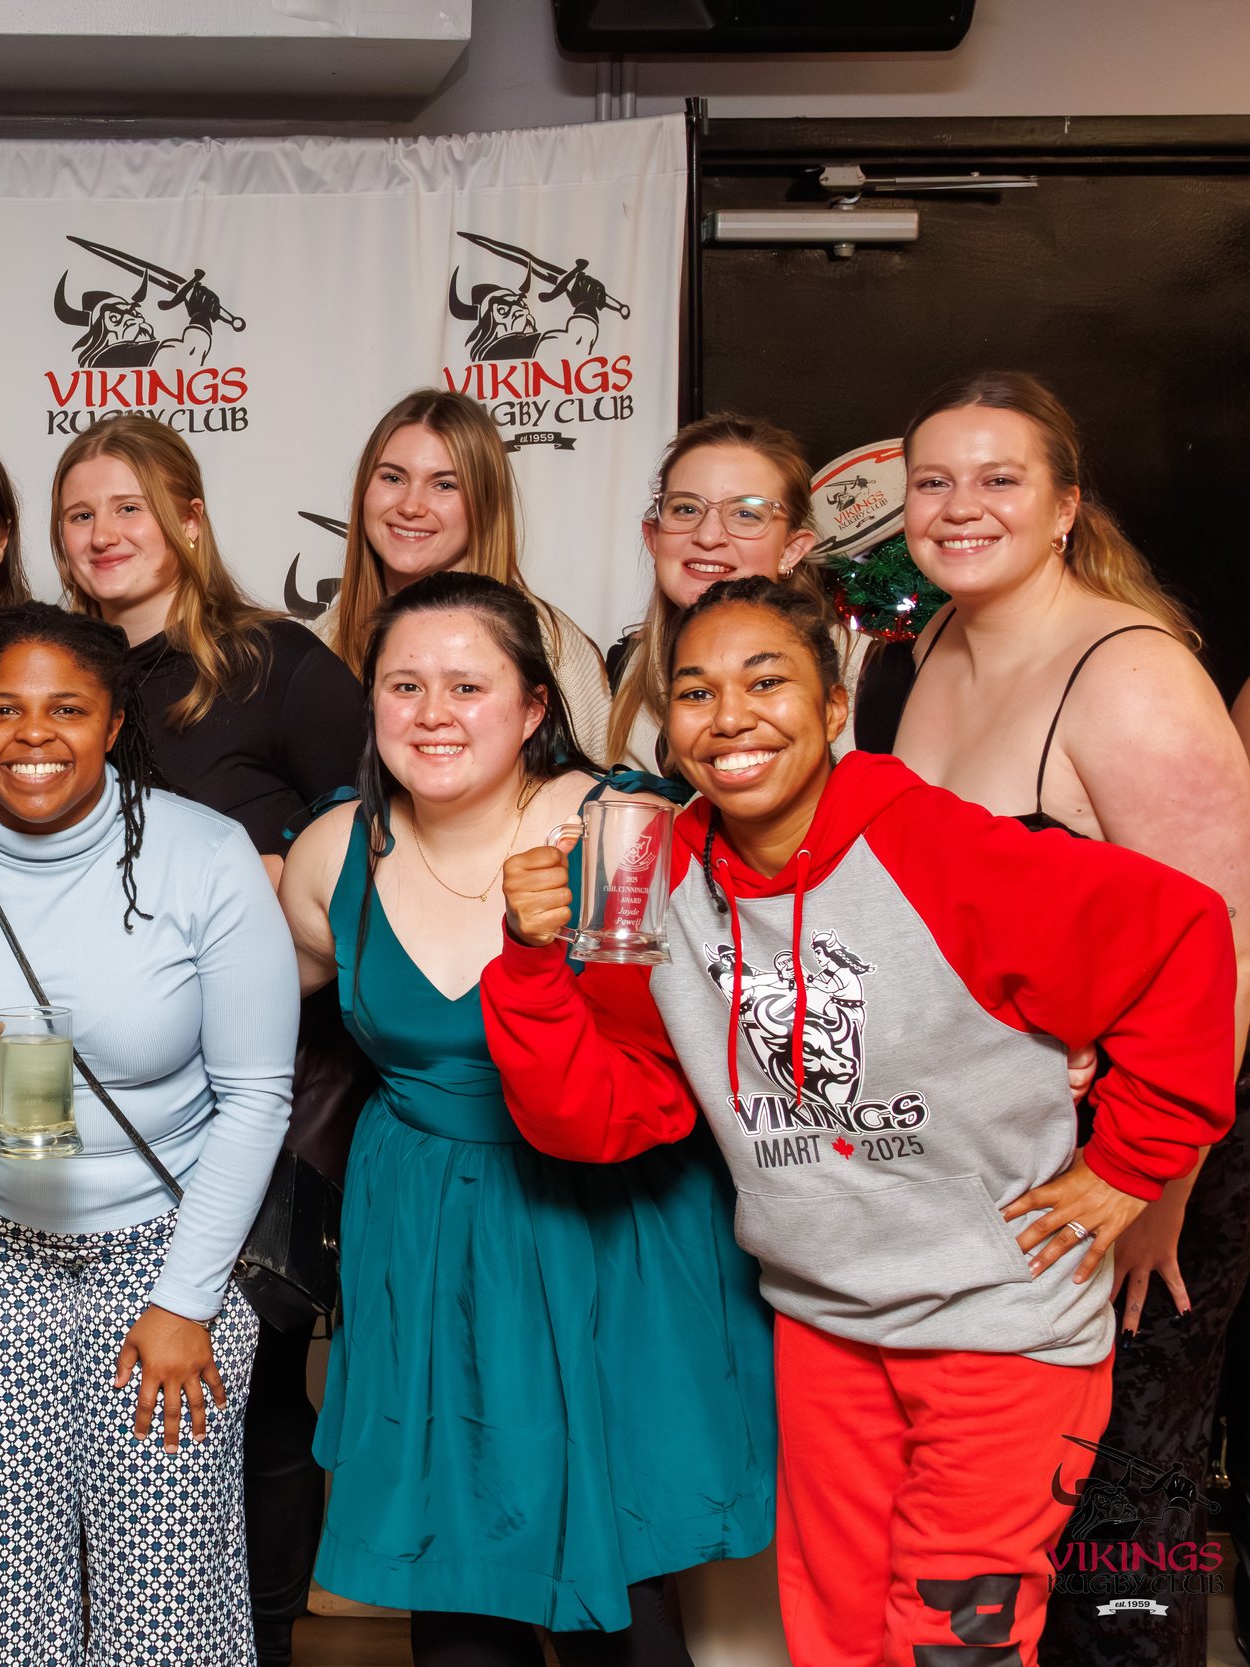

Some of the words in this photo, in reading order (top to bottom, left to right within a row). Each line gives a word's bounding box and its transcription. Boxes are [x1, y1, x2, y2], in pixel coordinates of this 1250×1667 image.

[44, 366, 249, 408] VIKINGS
[442, 354, 634, 400] VIKINGS
[167, 406, 249, 434] CLUB
[480, 399, 551, 427] GBY
[554, 394, 635, 424] CLUB
[529, 433, 555, 443] 1959
[833, 490, 885, 524] VIKINGS
[616, 917, 642, 925] Powell
[618, 907, 640, 917] Jayde
[727, 1090, 930, 1136] VIKINGS
[754, 1135, 821, 1169] IMART
[861, 1135, 925, 1162] 2025
